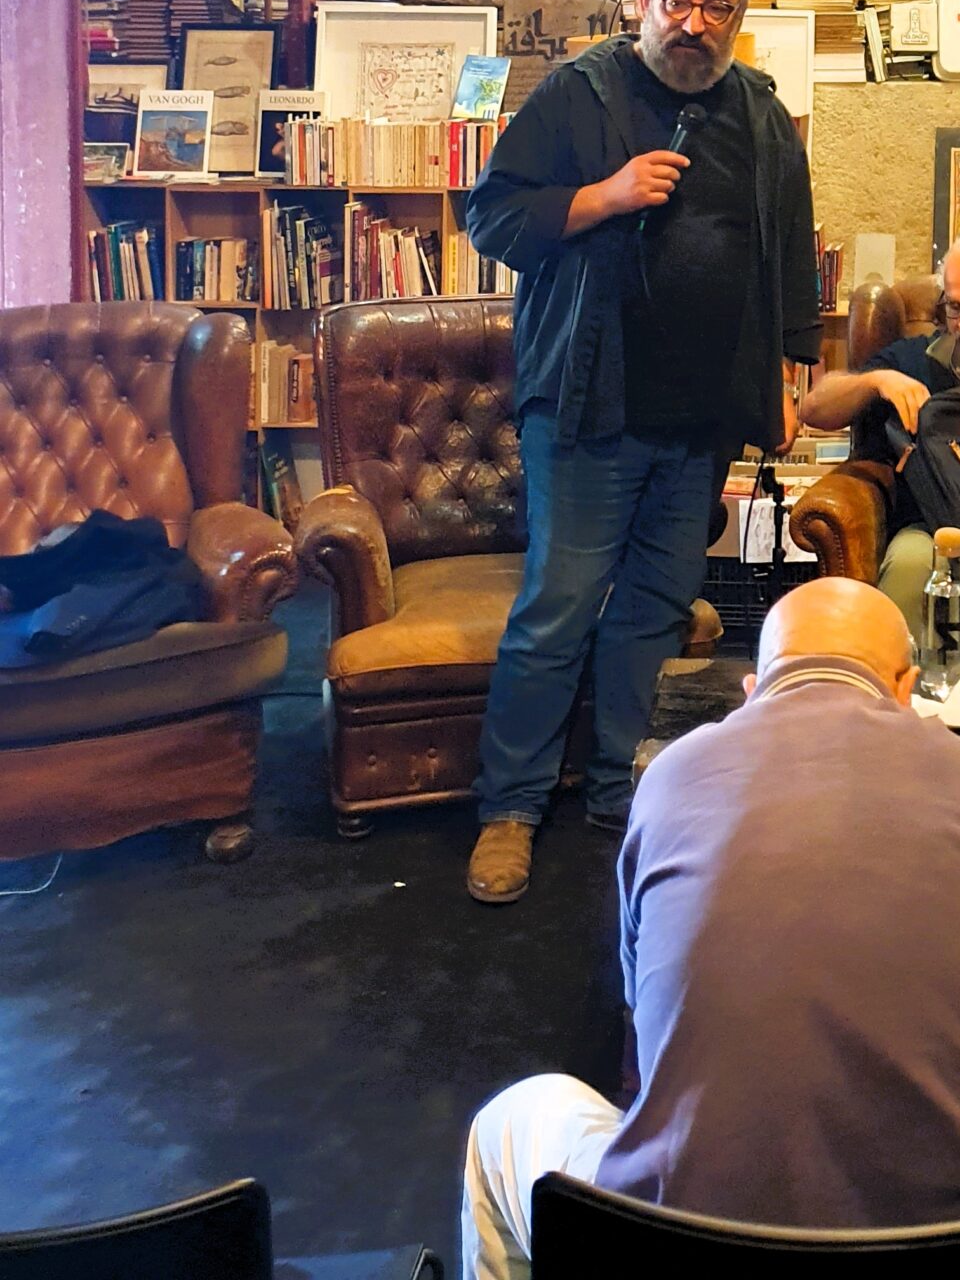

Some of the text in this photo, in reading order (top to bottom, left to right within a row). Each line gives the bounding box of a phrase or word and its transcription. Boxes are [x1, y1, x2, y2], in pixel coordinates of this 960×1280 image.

[149, 95, 204, 105] VAN GOGH
[269, 96, 315, 104] LEONARDO
